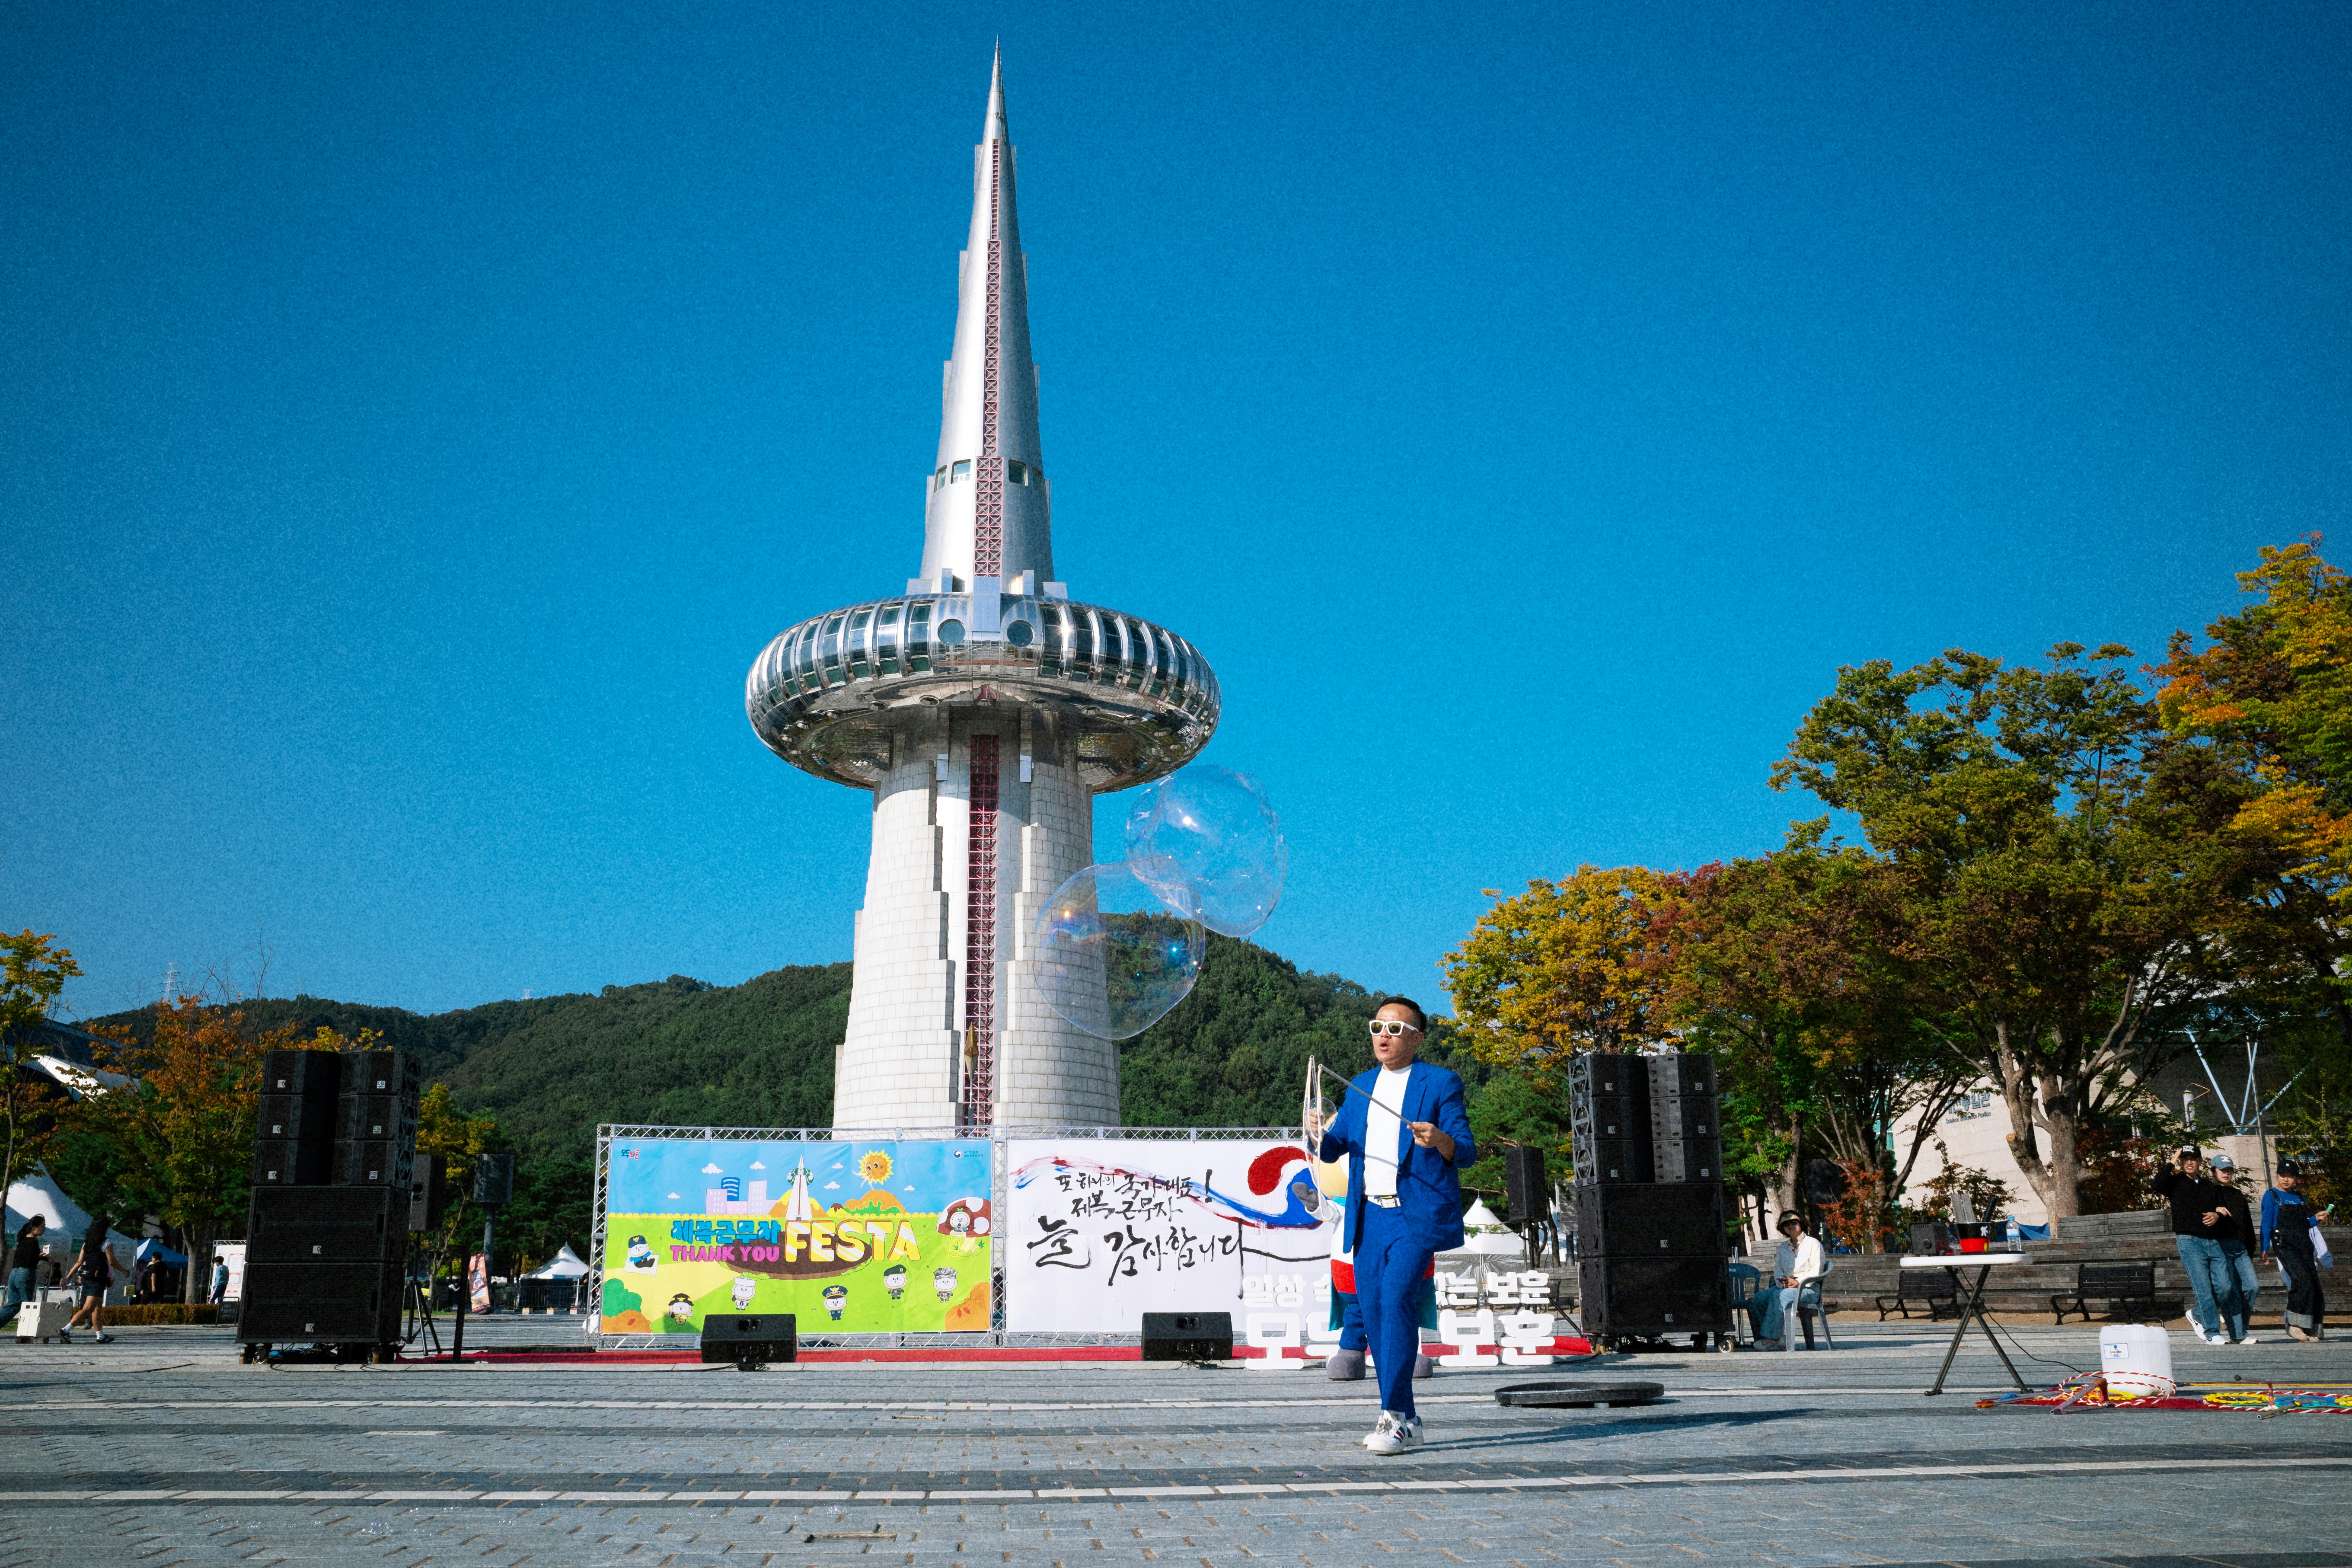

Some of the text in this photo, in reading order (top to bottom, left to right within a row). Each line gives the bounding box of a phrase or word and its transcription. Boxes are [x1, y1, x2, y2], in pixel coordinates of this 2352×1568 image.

[1054, 1175, 1073, 1192] 또
[1076, 1172, 1115, 1189] 하나의
[671, 1219, 782, 1244] 제복근무자
[784, 1219, 921, 1262] FESTA
[670, 1245, 780, 1262] THANK YOU
[1026, 1215, 1246, 1300] 늘 감사합니다
[1242, 1274, 1307, 1308] 일상
[1487, 1270, 1551, 1304] 보훈
[1438, 1308, 1555, 1367] 보훈
